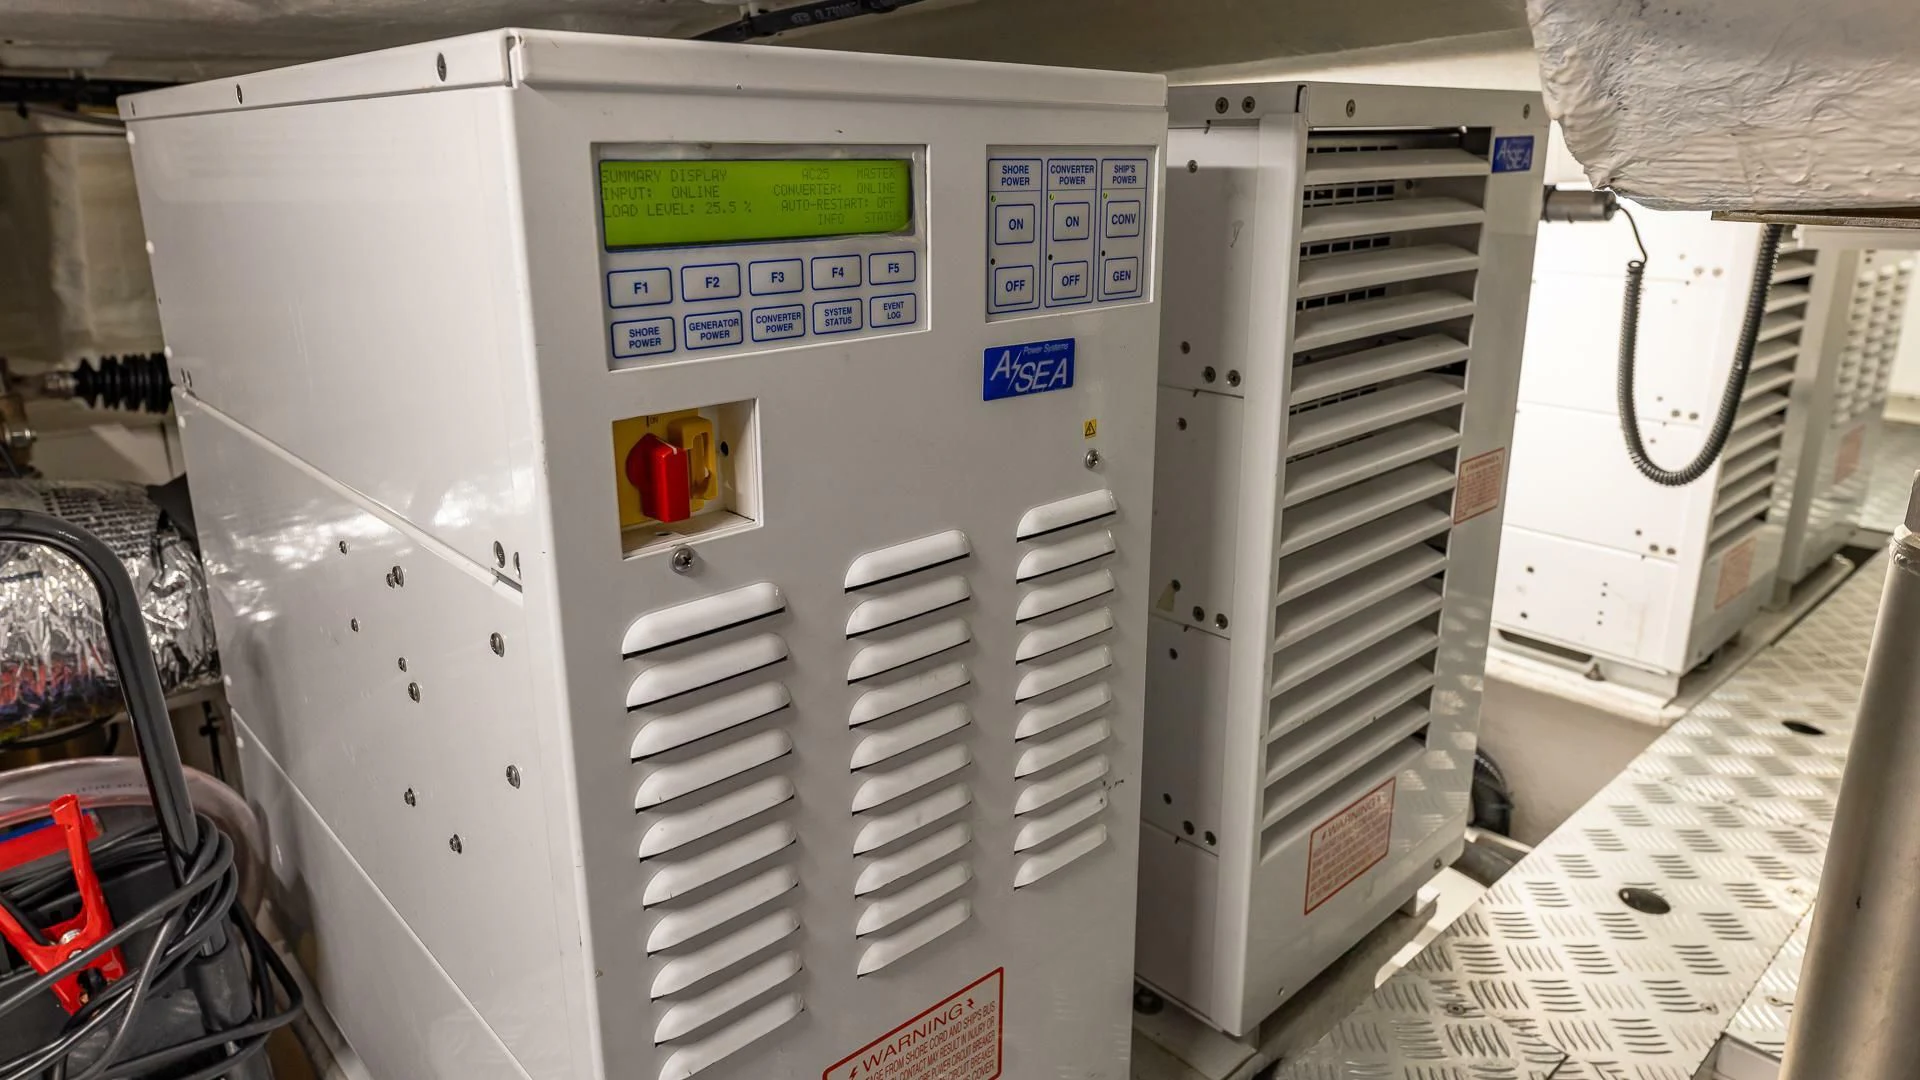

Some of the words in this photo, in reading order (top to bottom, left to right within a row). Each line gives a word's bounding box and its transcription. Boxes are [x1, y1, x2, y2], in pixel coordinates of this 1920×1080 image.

[802, 168, 829, 180] AC25
[857, 168, 896, 179] MASTER
[1002, 165, 1029, 174] SHORE
[1050, 164, 1094, 174] CONVERTER
[1114, 165, 1136, 173] SHIP'S
[601, 170, 662, 183] SUMMARY
[671, 169, 727, 182] DISPLAY
[1001, 177, 1030, 186] POWER
[1059, 176, 1086, 185] POWER
[1112, 175, 1137, 184] POWER
[602, 186, 652, 200] INPUT:
[672, 185, 720, 199] ONLINE
[773, 183, 841, 196] CONVERTER:
[857, 182, 896, 194] ONLINE
[604, 204, 639, 218] LOAD
[647, 202, 695, 216] LEVEL:
[706, 201, 737, 215] 25.5
[744, 200, 752, 213] %
[781, 197, 868, 212] AUTO-RESTART:
[877, 196, 896, 209] OFF
[818, 213, 844, 225] INFO
[1008, 218, 1024, 231] ON
[1065, 215, 1080, 228] ON
[1111, 213, 1137, 225] CONV
[832, 266, 844, 278] F4
[888, 262, 900, 274] F5
[771, 271, 785, 284] F3
[1061, 274, 1080, 287] OFF
[1112, 270, 1131, 282] GEN
[634, 282, 648, 295] F1
[705, 276, 720, 290] F2
[1005, 279, 1025, 292] OFF
[824, 306, 852, 317] SYSTEM
[883, 301, 904, 311] EVENT
[756, 312, 801, 325] CONVERTER
[887, 310, 901, 320] LOG
[688, 318, 740, 332] GENERATOR
[825, 316, 853, 327] STATUS
[629, 326, 660, 338] SHORE
[766, 322, 793, 334] POWER
[700, 329, 730, 341] POWER
[629, 337, 662, 349] POWER
[1023, 346, 1043, 355] Power
[1044, 343, 1069, 353] Systems
[863, 1003, 963, 1072] WARNING
[885, 1056, 905, 1078] FROM
[906, 1041, 928, 1065] SHORE
[930, 1030, 948, 1050] CORD
[949, 1021, 962, 1038] AND
[963, 1009, 982, 1030] SHIPS
[983, 1000, 995, 1017] BUS
[900, 1057, 927, 1080] CONTACT
[927, 1050, 940, 1066] MAY
[940, 1037, 960, 1058] RESULT
[961, 1031, 967, 1044] IN
[968, 1021, 985, 1042] INJURY
[986, 1015, 994, 1029] OR
[931, 1057, 951, 1077] POWER
[952, 1044, 971, 1066] CIRCUIT
[972, 1030, 995, 1053] BREAKER
[948, 1060, 969, 1080] CIRCUIT
[970, 1045, 995, 1069] BREAKER
